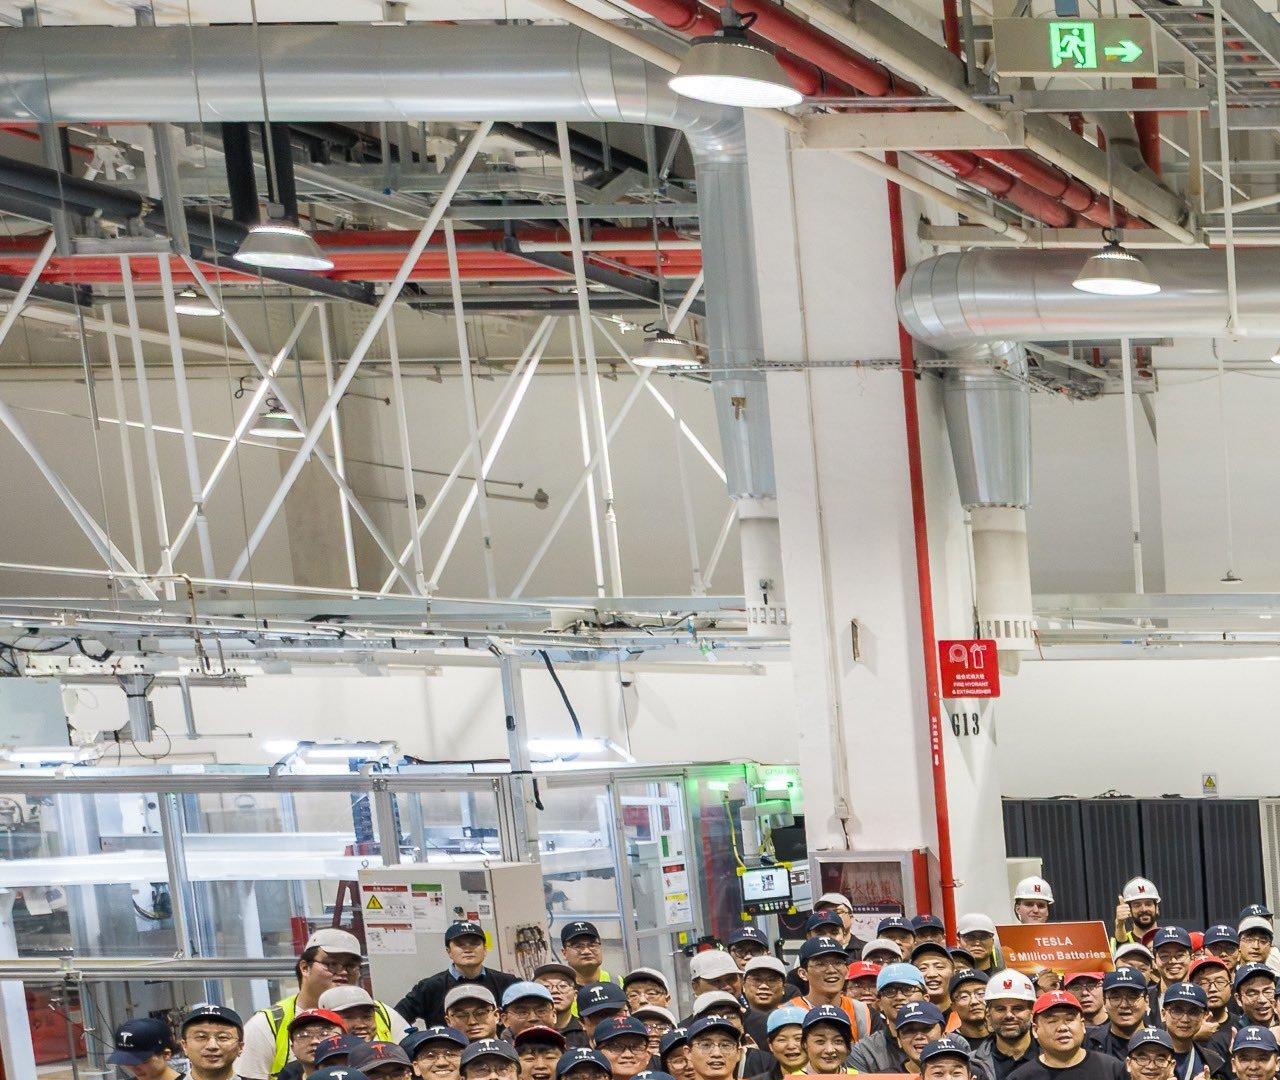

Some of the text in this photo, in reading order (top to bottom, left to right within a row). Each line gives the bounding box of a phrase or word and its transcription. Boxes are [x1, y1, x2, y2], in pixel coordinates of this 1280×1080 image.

[951, 712, 980, 737] G13
[1035, 936, 1073, 947] TESLA
[1009, 950, 1107, 962] 5 Million Batteries
